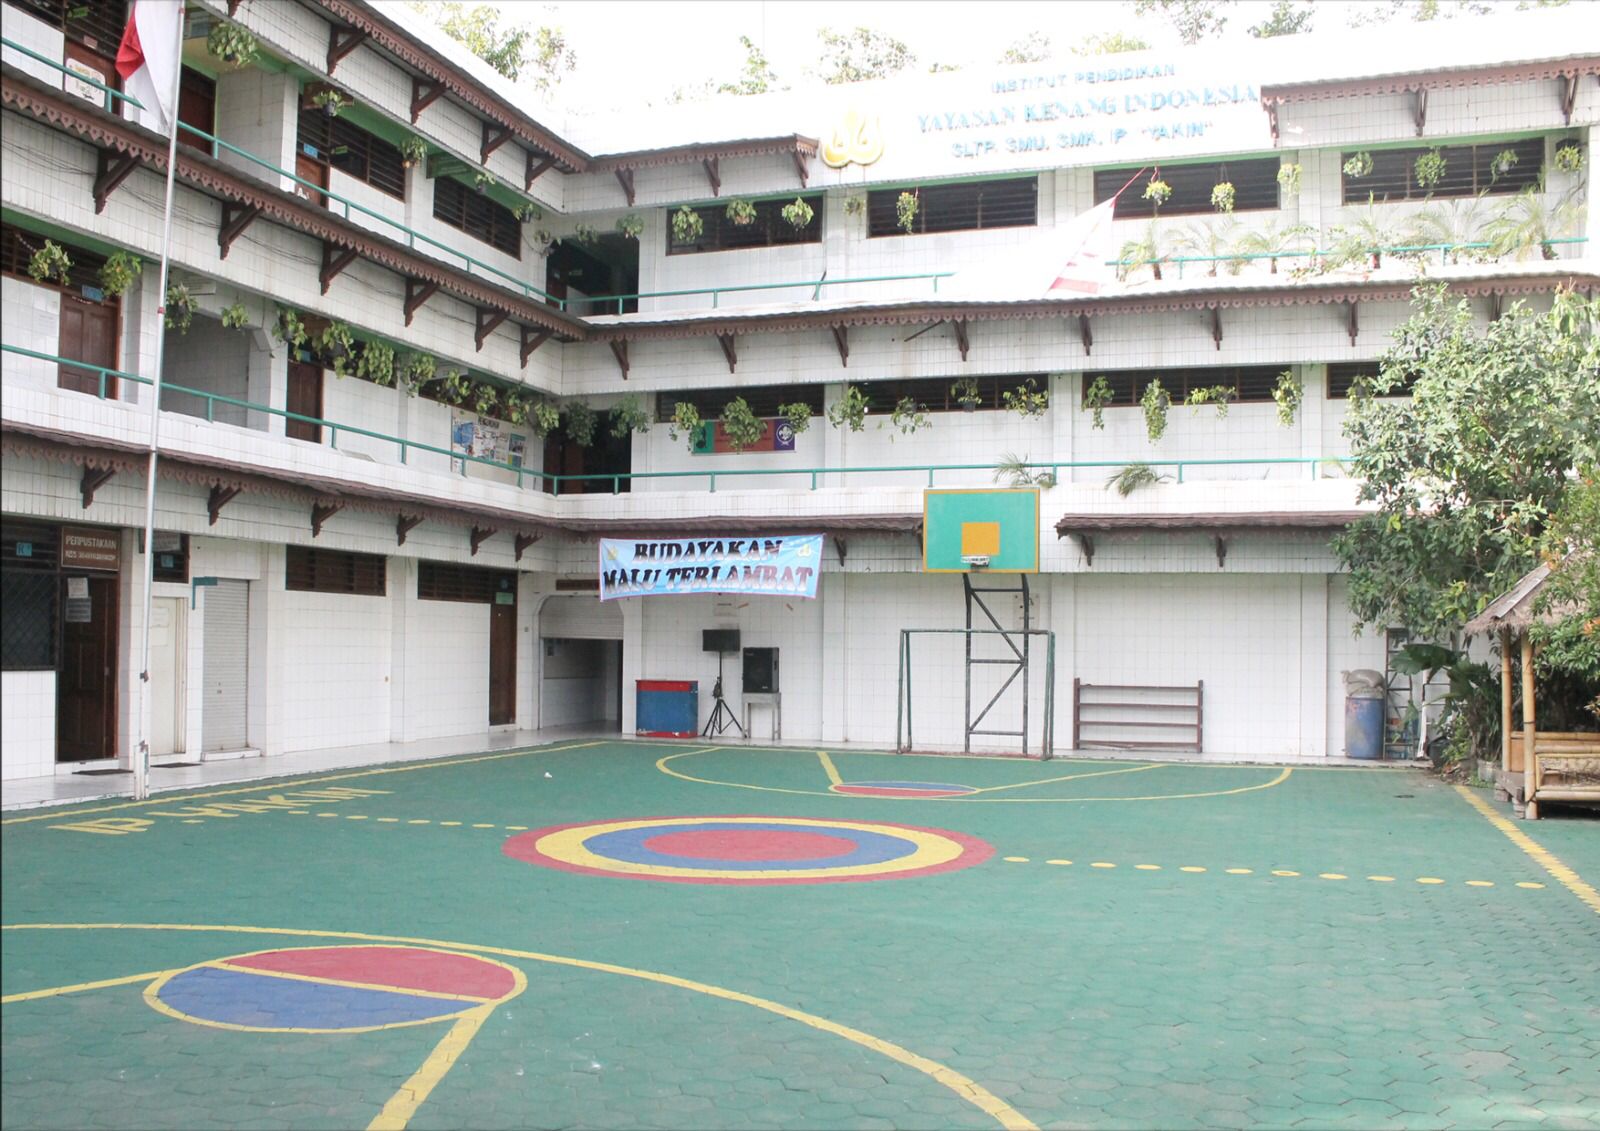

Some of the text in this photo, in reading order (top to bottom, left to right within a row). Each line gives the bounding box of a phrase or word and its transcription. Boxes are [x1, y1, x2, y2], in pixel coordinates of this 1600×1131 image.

[991, 63, 1176, 93] INSTITUT PENDIDIKAN
[917, 105, 1016, 133] YAYASAN
[1125, 82, 1261, 113] INDONESIA
[65, 535, 117, 549] PERPUSTAKAAN
[632, 539, 783, 563] BUDAYAKAN
[603, 564, 814, 594] MALU TERLAMBAT
